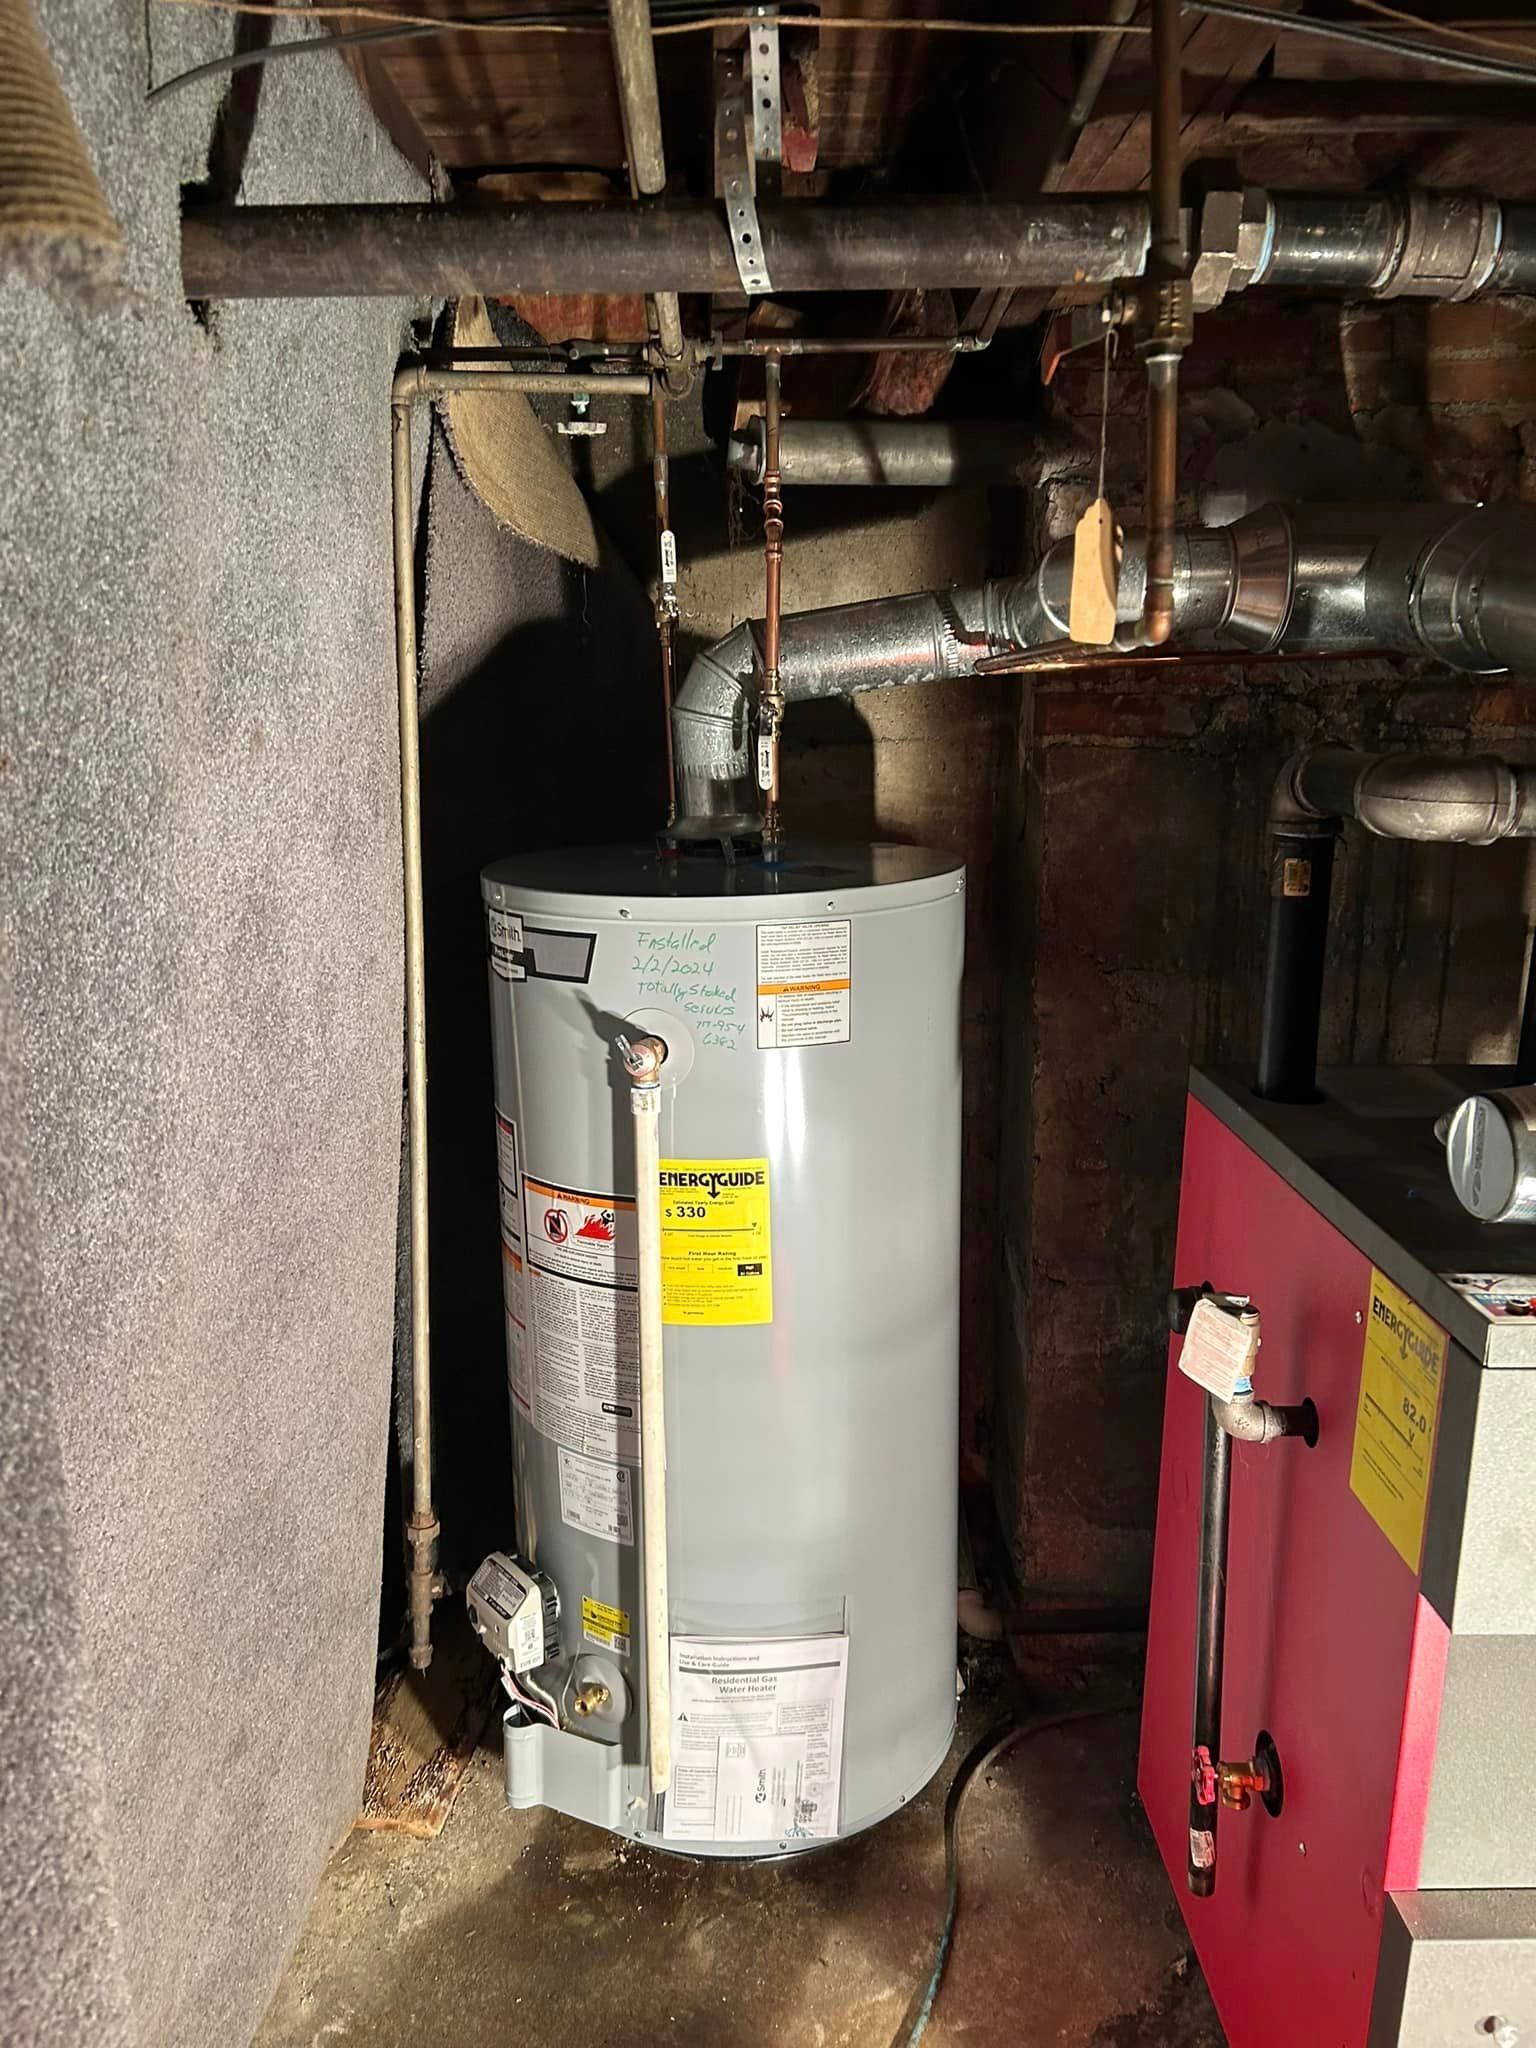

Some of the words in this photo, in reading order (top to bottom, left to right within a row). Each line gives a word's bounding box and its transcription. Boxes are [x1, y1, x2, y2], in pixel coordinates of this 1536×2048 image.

[632, 955, 714, 976] 2/2/2024
[659, 1171, 765, 1190] ENERGYGUIDE
[676, 1206, 706, 1218] 330
[1373, 1296, 1439, 1374] ENERGYGUIDE
[1402, 1398, 1427, 1433] 82.0
[711, 1675, 760, 1686] Residential
[761, 1674, 778, 1684] Gas
[719, 1685, 746, 1694] Water
[747, 1684, 777, 1693] Heater
